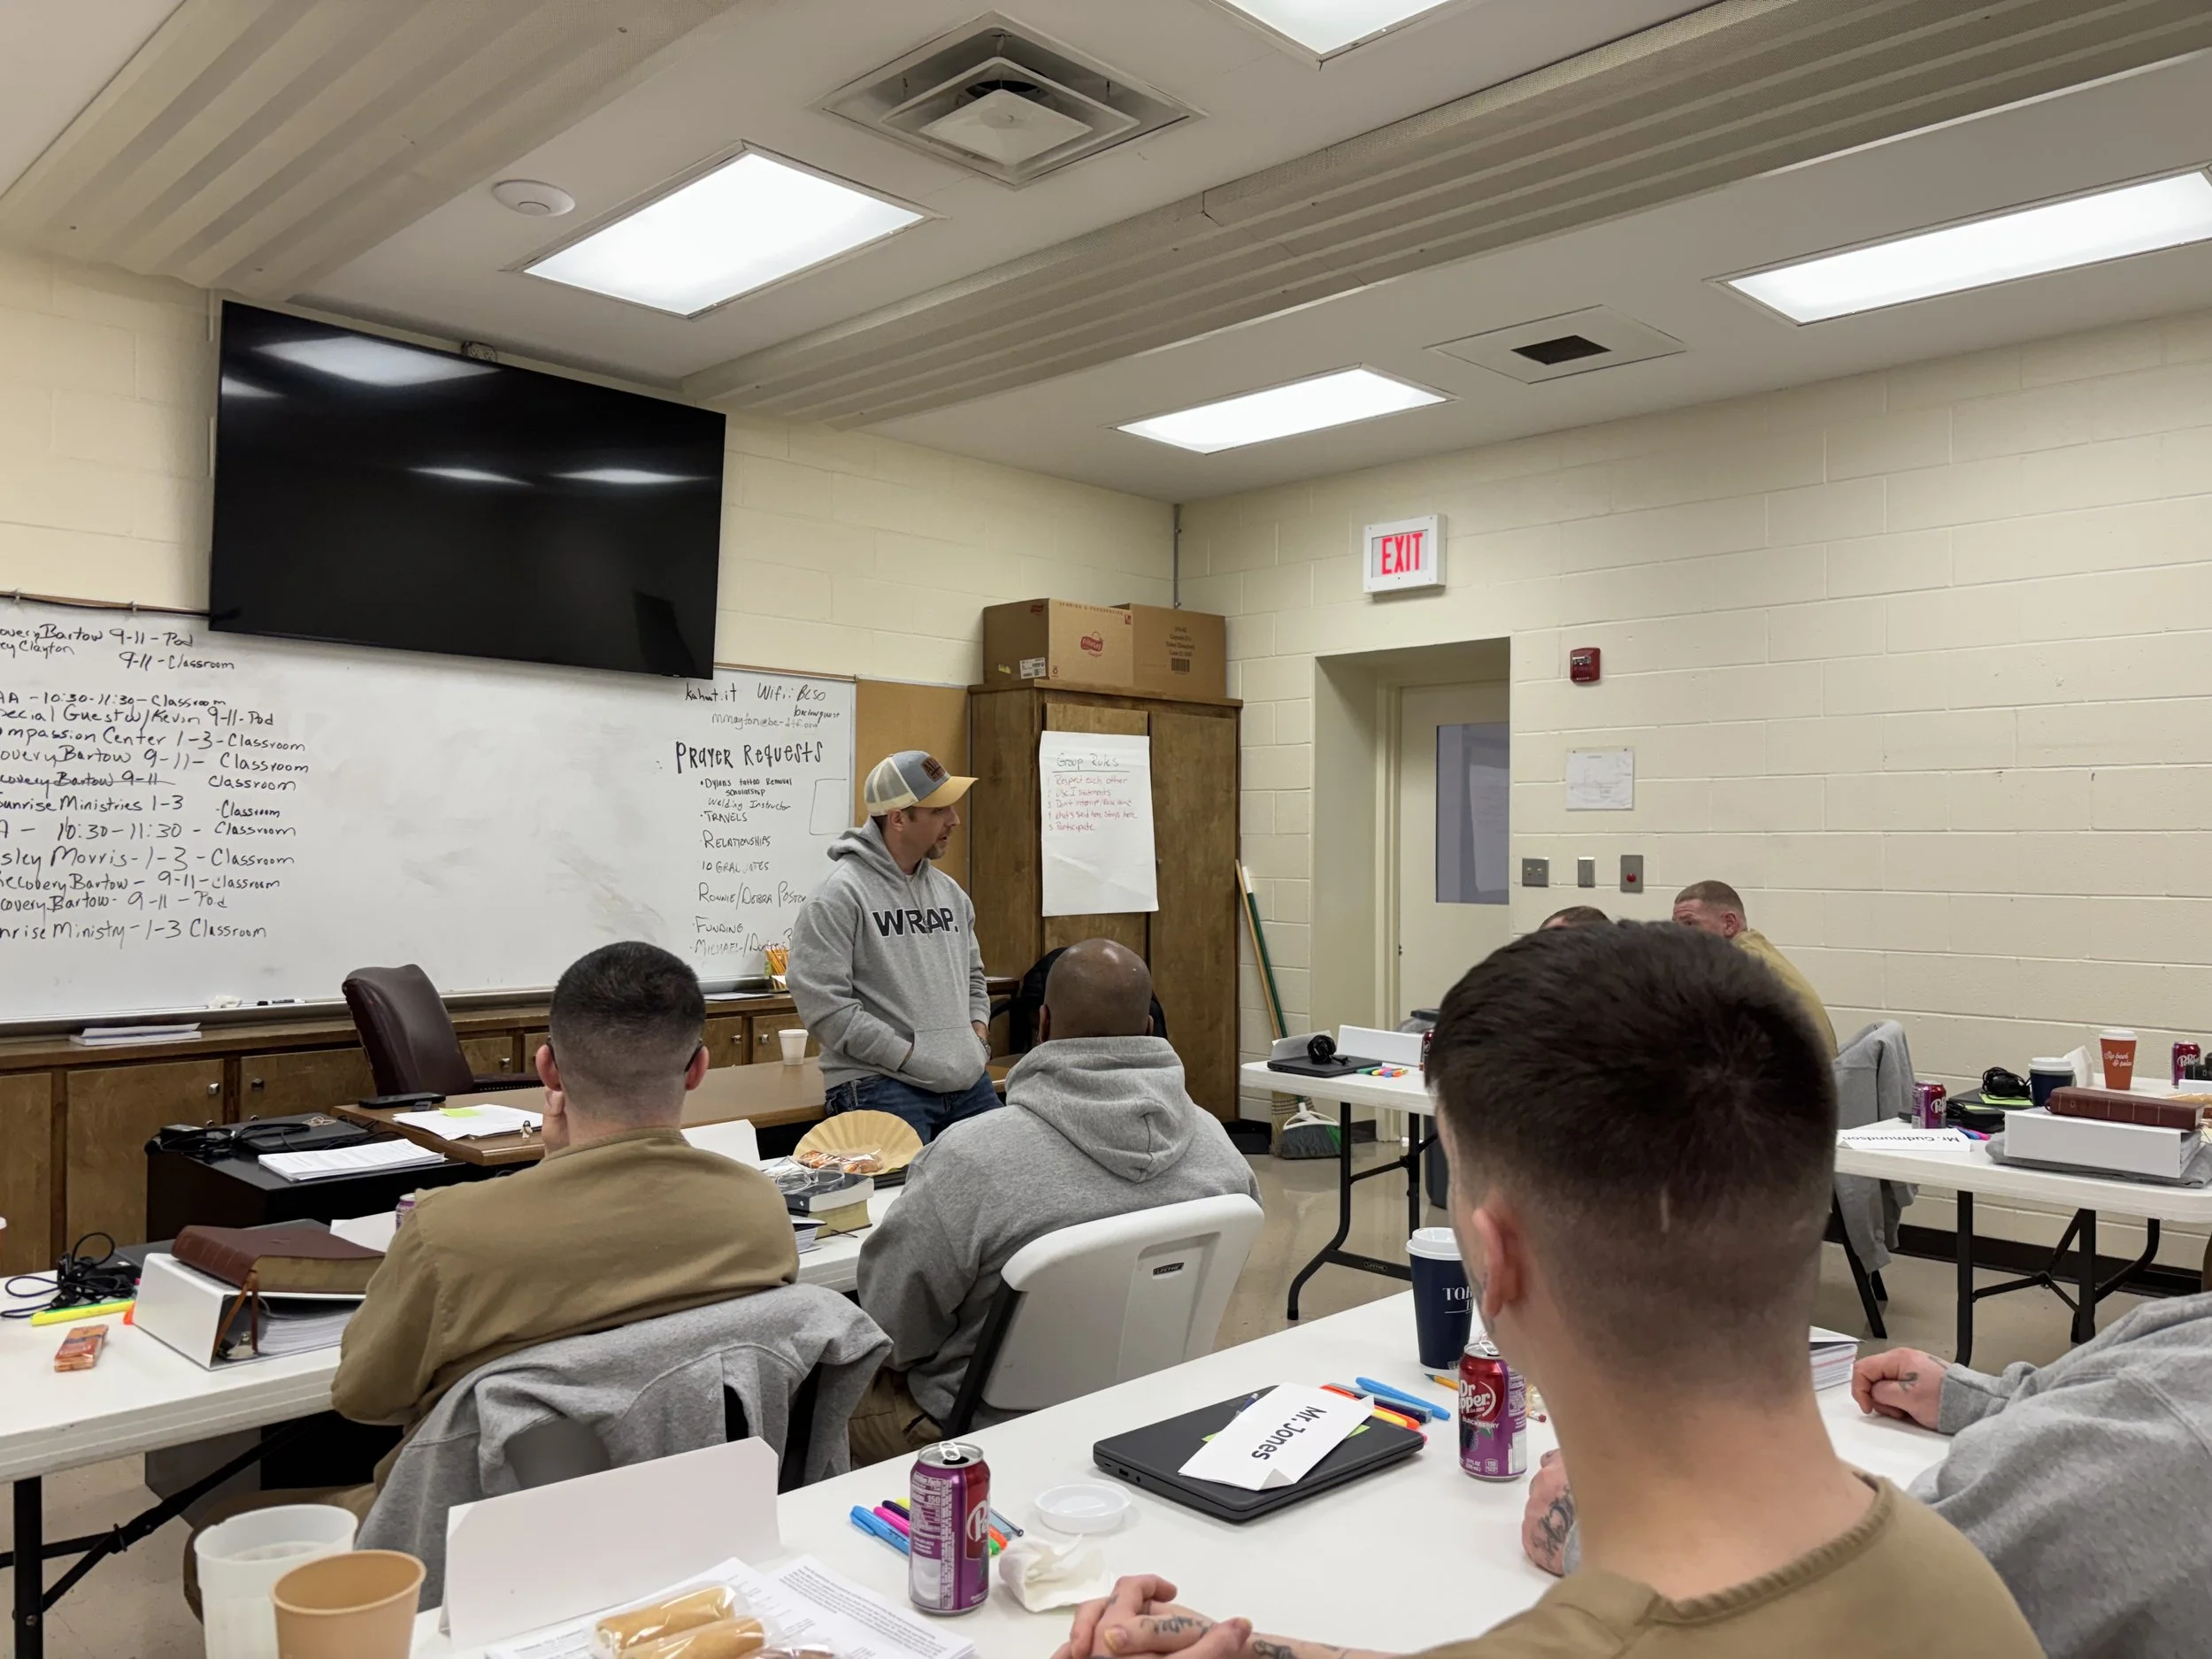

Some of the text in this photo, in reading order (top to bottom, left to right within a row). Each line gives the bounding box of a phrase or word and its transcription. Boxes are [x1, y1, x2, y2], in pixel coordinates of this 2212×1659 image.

[1380, 532, 1423, 575] EXIT
[39, 623, 103, 641] Bartow
[110, 628, 144, 645] 9-11
[163, 631, 193, 647] Pod
[19, 640, 75, 659] Clayton
[119, 651, 152, 671] 9-11
[168, 654, 234, 670] Classroom
[151, 694, 227, 708] Classroom
[796, 684, 826, 702] BCSO
[64, 703, 123, 722] Guest
[248, 710, 273, 726] Pod
[104, 726, 166, 746] Center
[227, 733, 306, 751] Classroom
[58, 745, 132, 763] Bartow
[219, 752, 309, 773] Classroom
[1056, 752, 1119, 770] Group Rules
[53, 771, 114, 787] Bartow
[208, 775, 296, 792] Classroom
[1054, 774, 1083, 786] Respect
[59, 795, 142, 812] Ministries
[152, 795, 184, 811] 1-3
[708, 797, 743, 811] Welding
[703, 810, 749, 824] TRAVELS
[214, 821, 296, 836] Classroom
[211, 848, 295, 867] Classroom
[69, 872, 128, 890] Bartow
[157, 871, 195, 889] 9-11
[211, 875, 280, 889] Classroom
[194, 891, 228, 909] Pod
[146, 919, 181, 941] 1-3
[190, 918, 267, 939] Classroom
[1459, 1379, 1476, 1396] Dr
[1251, 1406, 1327, 1461] Mr. Jones
[928, 1494, 941, 1504] 150
